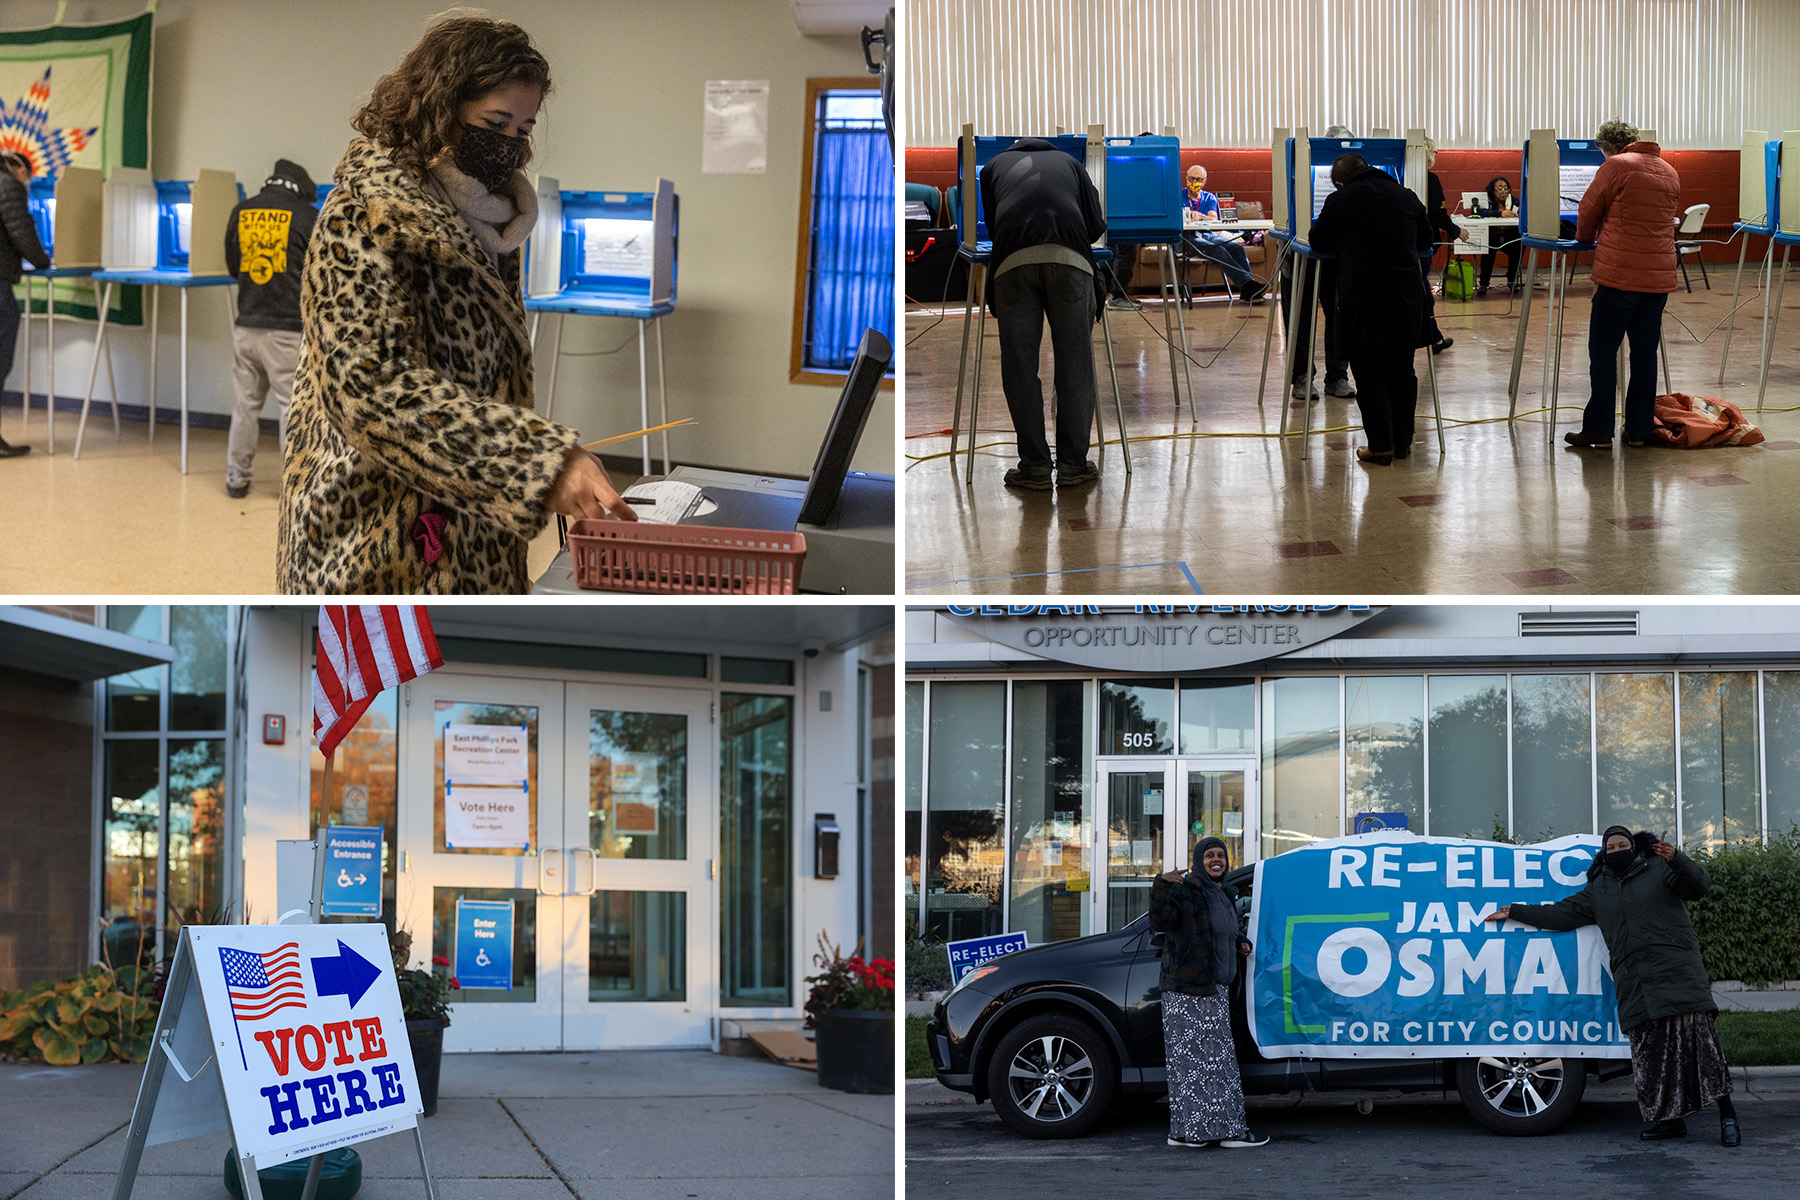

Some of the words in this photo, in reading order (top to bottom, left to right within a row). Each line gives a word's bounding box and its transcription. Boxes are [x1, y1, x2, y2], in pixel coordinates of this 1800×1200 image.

[241, 212, 289, 223] STAND
[1024, 625, 1198, 647] OPPORTUNITY
[1204, 624, 1301, 645] CENTER
[471, 735, 499, 744] Phillips
[501, 736, 518, 744] Park
[1122, 732, 1154, 748] 505
[452, 745, 493, 753] Recreation
[459, 802, 485, 812] Vote
[488, 803, 515, 813] Here
[330, 838, 376, 849] Accessible
[333, 849, 372, 860] Entrance
[1328, 847, 1602, 888] RE-ELEC
[474, 918, 497, 929] Enter
[1396, 901, 1560, 933] JAM
[474, 929, 496, 939] Here
[952, 941, 1023, 962] RE-ELECT
[1331, 1021, 1390, 1042] FOR
[1402, 1020, 1477, 1042] CITY
[254, 1016, 388, 1077] VOTE
[260, 1062, 406, 1136] HERE
